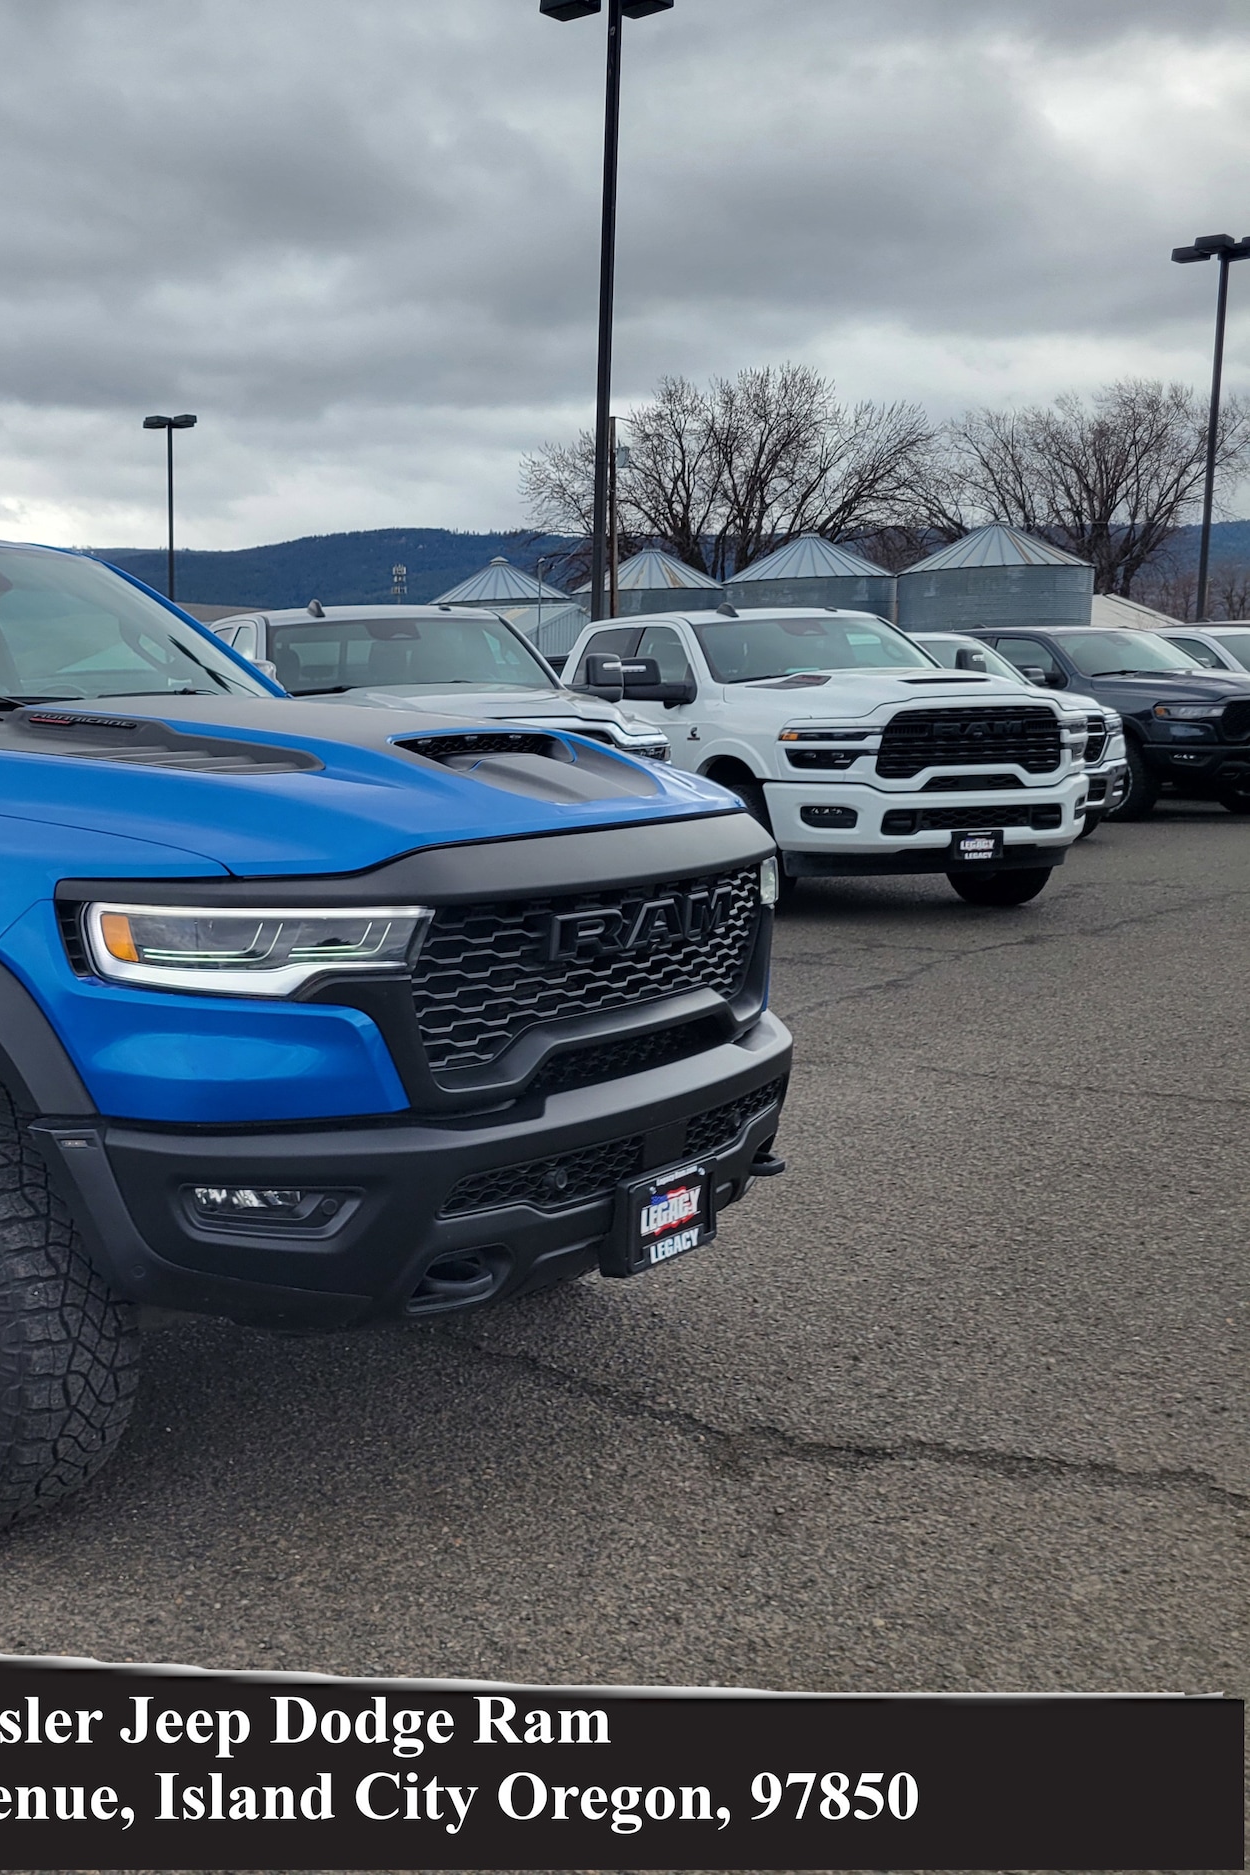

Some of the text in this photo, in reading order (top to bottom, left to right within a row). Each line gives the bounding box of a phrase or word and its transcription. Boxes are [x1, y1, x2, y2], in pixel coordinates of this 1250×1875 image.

[32, 712, 138, 727] HURRICANE
[933, 720, 1023, 736] RAM
[960, 839, 995, 850] LEGACY
[551, 885, 732, 962] RAM
[640, 1187, 701, 1235] LEGACY
[650, 1227, 699, 1264] LEGACY
